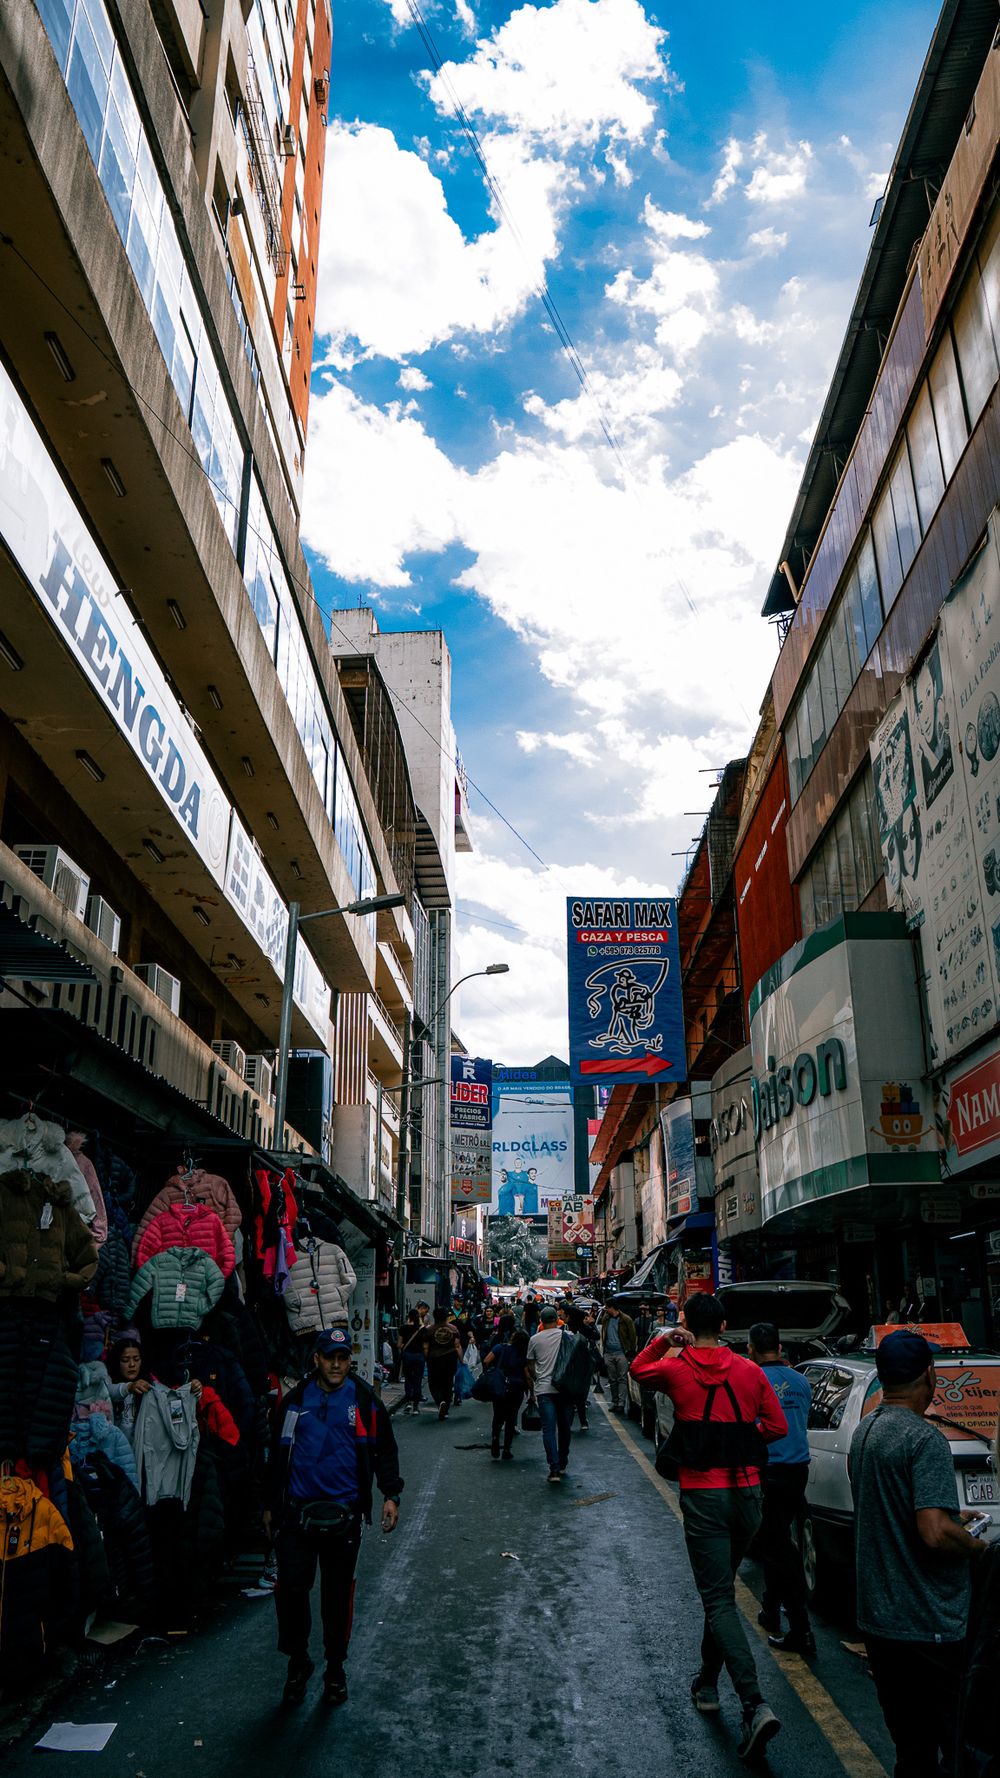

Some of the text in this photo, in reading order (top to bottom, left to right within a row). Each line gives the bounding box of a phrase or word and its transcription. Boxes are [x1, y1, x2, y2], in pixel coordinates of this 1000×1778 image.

[39, 528, 201, 841] HENGDA
[572, 901, 672, 928] SAFARI MAX
[581, 933, 664, 942] CAZA Y PESCA
[498, 1068, 537, 1080] Midea
[450, 1081, 488, 1105] LIDER
[454, 1107, 482, 1115] PRECIOS
[459, 1112, 487, 1121] FÁBRICA
[454, 1133, 480, 1147] METRÓ
[563, 1202, 584, 1212] AB
[971, 1484, 994, 1501] CAB
